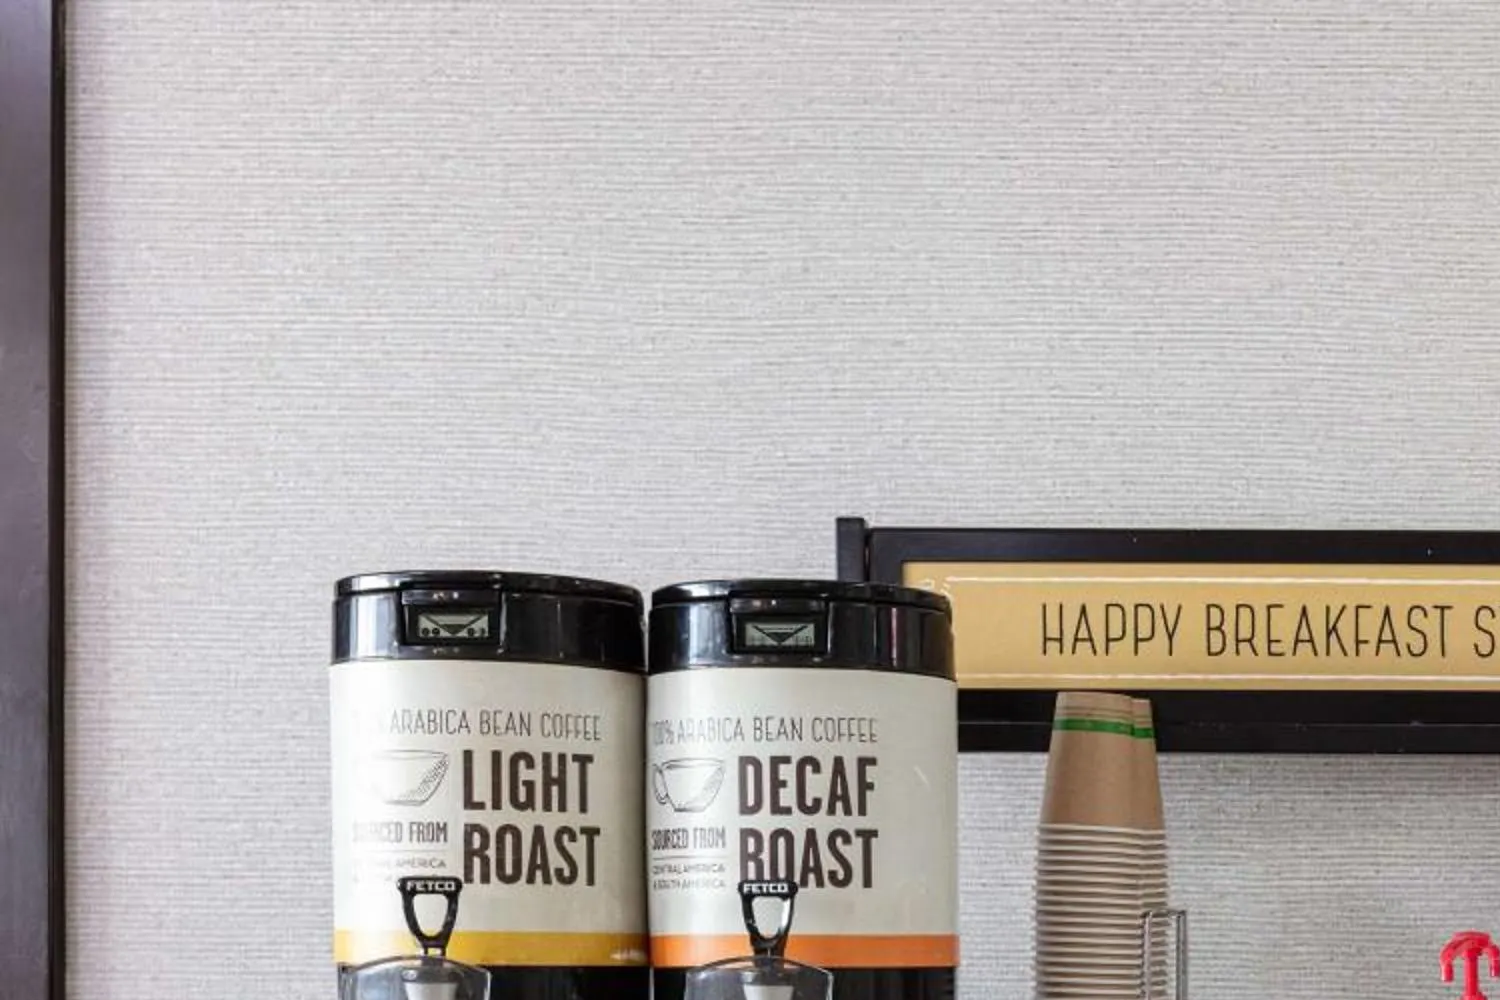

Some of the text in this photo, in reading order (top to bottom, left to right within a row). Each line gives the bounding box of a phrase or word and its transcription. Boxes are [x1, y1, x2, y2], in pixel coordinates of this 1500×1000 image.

[1041, 602, 1182, 656] HAPPY
[1205, 603, 1454, 658] BREAKFAST
[390, 709, 471, 736] ARABICA
[480, 711, 531, 737] BEAN
[541, 713, 601, 741] COFFEE
[678, 717, 745, 744] ARABICA
[753, 716, 803, 742] BEAN
[811, 717, 878, 743] COFFEE
[462, 749, 594, 813] LIGHT
[738, 755, 878, 816] DECAF
[409, 821, 448, 843] FROM
[693, 825, 726, 849] FROM
[463, 823, 601, 886] ROAST
[739, 827, 878, 889] ROAST
[407, 881, 455, 892] FETCO
[743, 883, 790, 894] FETCO
